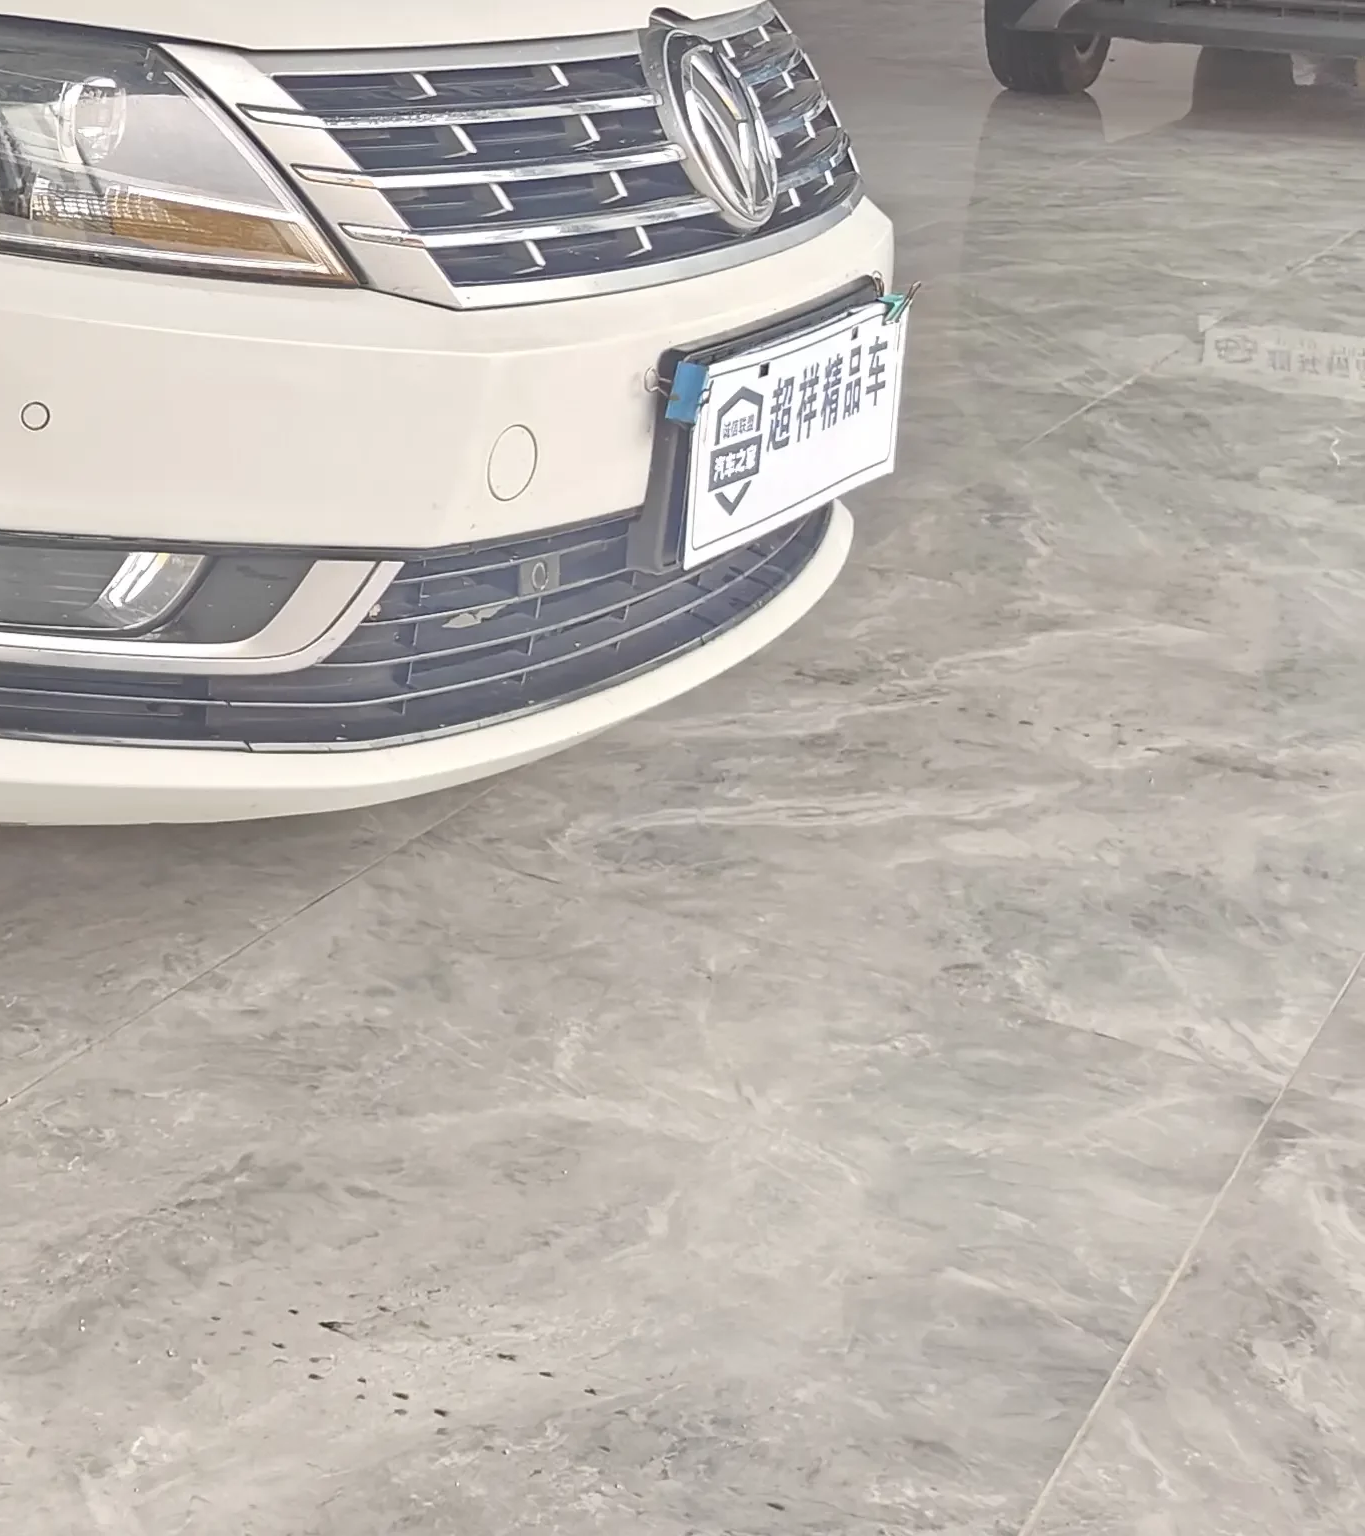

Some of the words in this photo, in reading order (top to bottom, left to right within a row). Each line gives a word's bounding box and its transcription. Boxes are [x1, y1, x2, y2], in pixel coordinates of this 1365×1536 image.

[766, 335, 888, 453] 超祥精品车
[713, 444, 758, 482] 汽车之家
